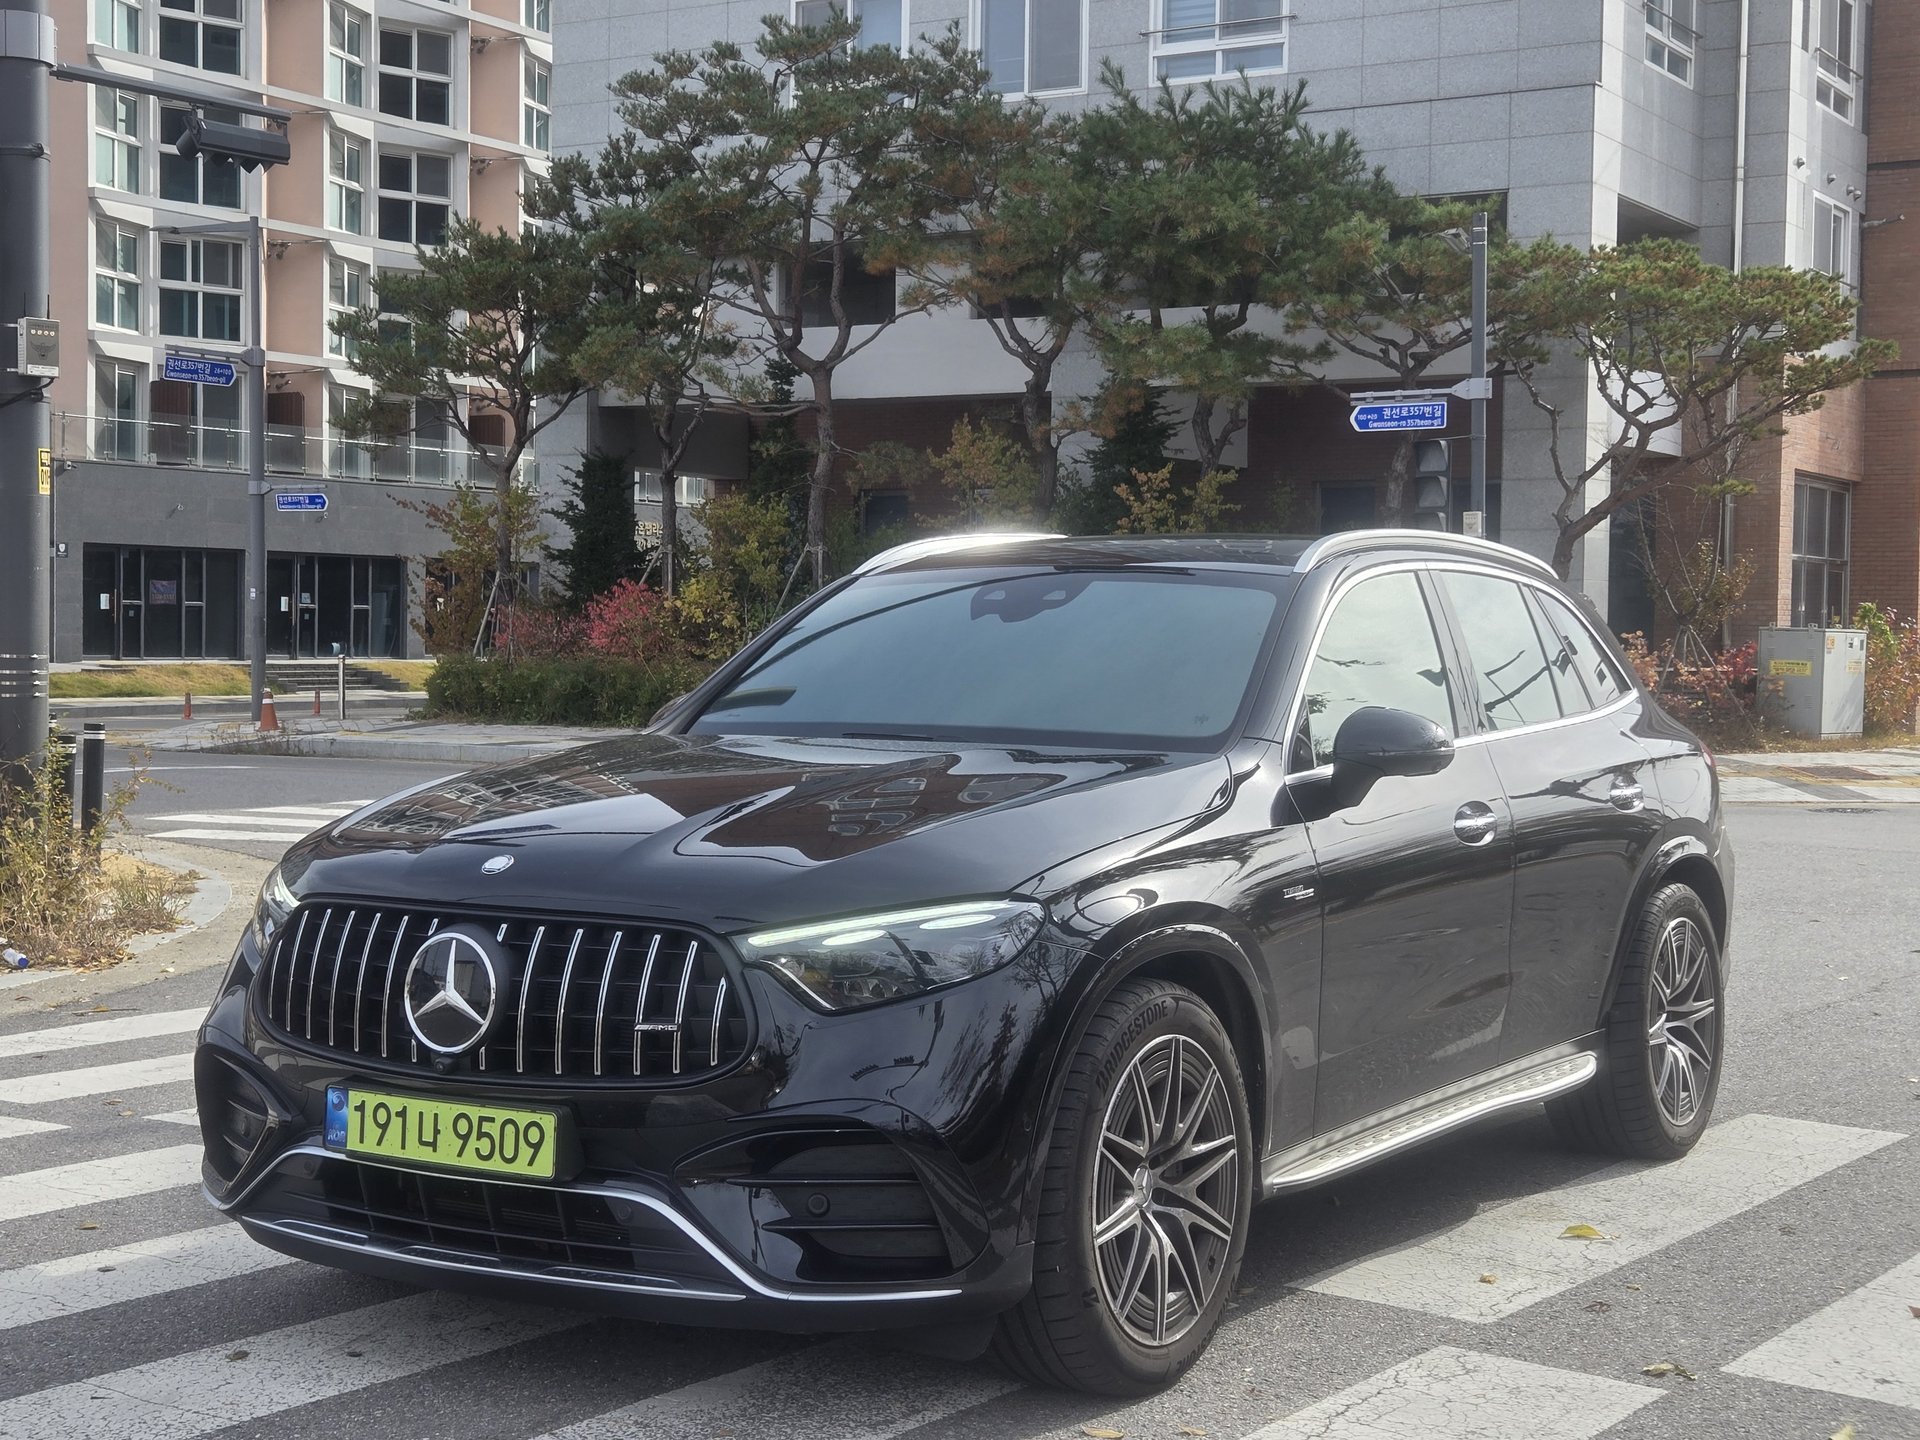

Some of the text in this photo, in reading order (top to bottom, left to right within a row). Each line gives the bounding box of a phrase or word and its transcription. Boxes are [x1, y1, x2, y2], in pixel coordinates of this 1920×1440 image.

[167, 358, 211, 374] 권선로357번길
[1382, 405, 1442, 419] 권선로357번길
[1368, 418, 1442, 428] Gwonseon-ro 357beon-gil
[1096, 1000, 1168, 1091] BRIDGESTONE
[353, 1099, 546, 1167] 191나 9509
